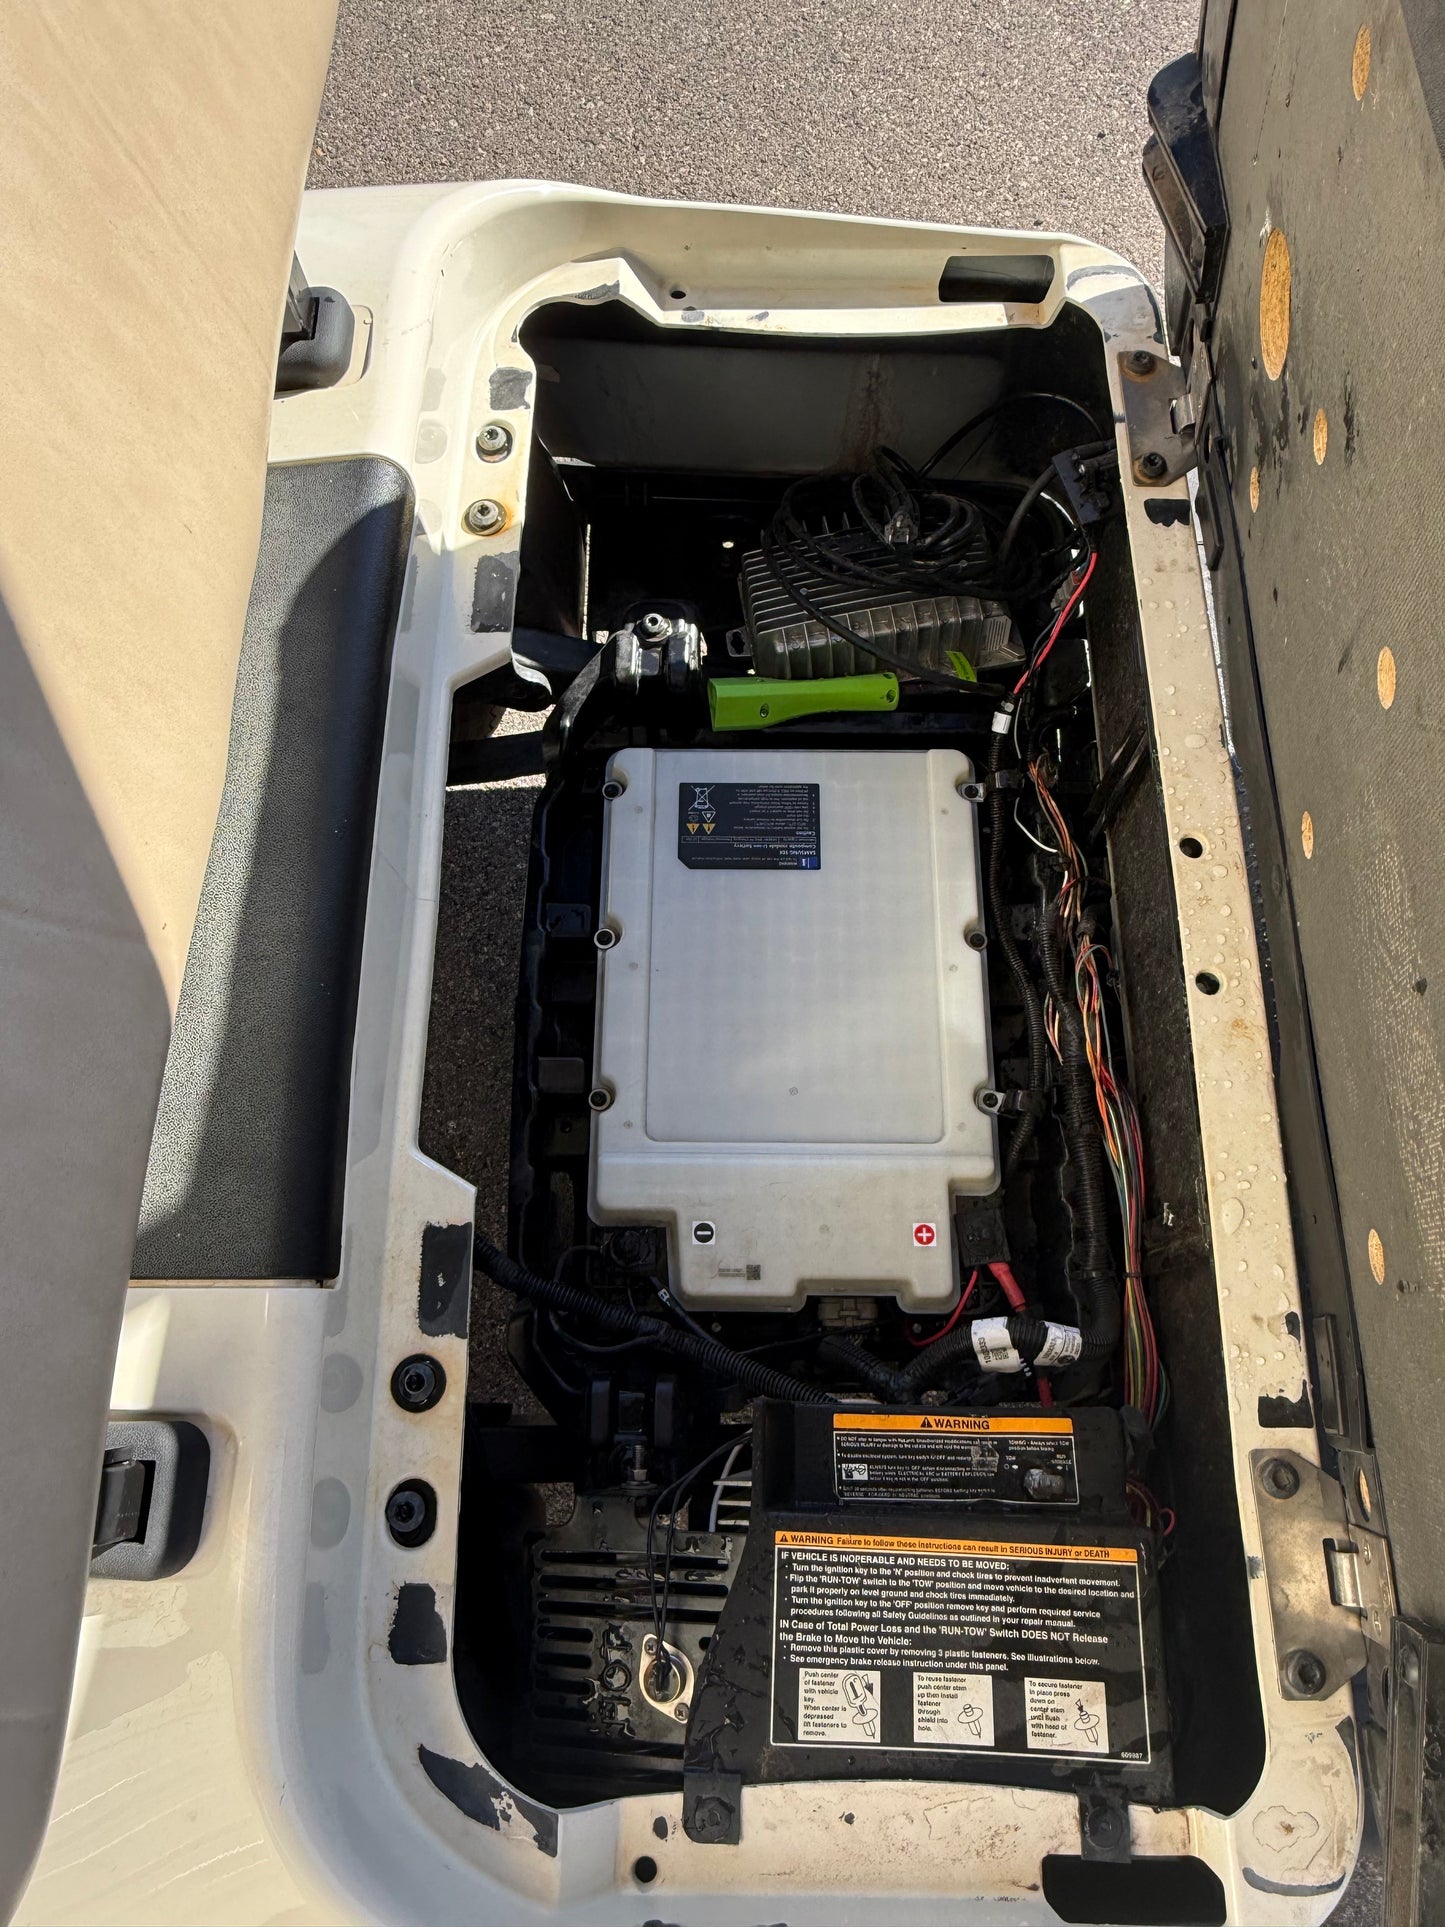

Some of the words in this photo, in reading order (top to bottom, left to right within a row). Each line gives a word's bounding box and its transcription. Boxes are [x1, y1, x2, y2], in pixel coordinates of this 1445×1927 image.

[933, 1418, 990, 1429] WARNING
[790, 1534, 833, 1544] WARNING
[836, 1535, 862, 1545] Failure
[872, 1538, 895, 1547] follow
[896, 1540, 917, 1548] these
[977, 1544, 999, 1552] result
[1009, 1545, 1043, 1555] SERIOUS
[1044, 1547, 1072, 1556] INJURY
[1083, 1549, 1110, 1558] DEATH
[781, 1551, 789, 1559] IF
[790, 1551, 827, 1561] VEHICLE
[829, 1553, 838, 1561] IS
[839, 1553, 895, 1564] INOPERABLE
[896, 1556, 915, 1565] AND
[917, 1557, 946, 1566] NEEDS
[947, 1559, 960, 1567] TO
[961, 1559, 973, 1568] BE
[975, 1560, 1009, 1570] MOVED:
[789, 1573, 804, 1583] Flip
[805, 1574, 817, 1582] the
[863, 1577, 887, 1585] switch
[935, 1580, 965, 1590] position
[1005, 1584, 1032, 1592] vehicle
[1058, 1587, 1086, 1595] desired
[1088, 1589, 1118, 1597] location
[791, 1563, 809, 1571] Turn
[810, 1564, 823, 1572] the
[854, 1566, 868, 1575] key
[879, 1567, 891, 1575] the
[904, 1568, 934, 1578] position
[951, 1570, 974, 1579] chock
[1004, 1574, 1033, 1583] prevent
[1078, 1578, 1120, 1586] movement.
[791, 1585, 807, 1594] park
[816, 1586, 848, 1596] properly
[861, 1588, 879, 1596] level
[881, 1589, 907, 1599] ground
[925, 1590, 947, 1598] chock
[949, 1591, 966, 1599] tires
[790, 1606, 833, 1617] procedures
[835, 1608, 869, 1619] following
[882, 1610, 906, 1620] Safety
[908, 1611, 947, 1621] Guidelines
[960, 1613, 990, 1622] outlined
[1001, 1617, 1018, 1625] your
[1021, 1617, 1043, 1626] repair
[1045, 1618, 1075, 1627] manual.
[791, 1595, 808, 1603] Turn
[810, 1596, 822, 1604] the
[854, 1598, 868, 1608] key
[914, 1601, 944, 1611] position
[975, 1603, 989, 1613] key
[990, 1604, 1005, 1612] and
[1006, 1605, 1037, 1615] perform
[1038, 1607, 1071, 1617] required
[1072, 1610, 1100, 1618] service
[779, 1632, 793, 1640] the
[796, 1632, 821, 1642] Brake
[824, 1634, 832, 1642] to
[835, 1634, 858, 1643] Move
[861, 1635, 874, 1644] the
[877, 1635, 911, 1645] Vehicle:
[780, 1619, 788, 1628] IN
[791, 1619, 813, 1629] Case
[815, 1620, 824, 1629] of
[827, 1621, 848, 1631] Total
[851, 1622, 878, 1632] Power
[881, 1623, 901, 1633] Loss
[904, 1624, 920, 1633] and
[923, 1625, 936, 1634] the
[989, 1627, 1018, 1638] Switch
[1021, 1629, 1047, 1639] DOES
[1050, 1631, 1069, 1641] NOT
[1072, 1632, 1107, 1643] Release
[789, 1654, 805, 1662] See
[806, 1656, 848, 1666] emergency
[850, 1657, 872, 1665] brake
[873, 1658, 901, 1666] release
[944, 1660, 967, 1668] under
[968, 1661, 983, 1669] this
[985, 1662, 1008, 1672] panel.
[790, 1643, 821, 1652] Remove
[823, 1644, 837, 1652] this
[839, 1645, 864, 1655] plastic
[866, 1647, 888, 1655] cover
[889, 1647, 899, 1656] by
[900, 1647, 936, 1658] removing
[937, 1648, 943, 1656] 3
[944, 1649, 969, 1659] plastic
[971, 1650, 1009, 1659] fasteners.
[1010, 1652, 1025, 1660] See
[1074, 1656, 1100, 1665] below.
